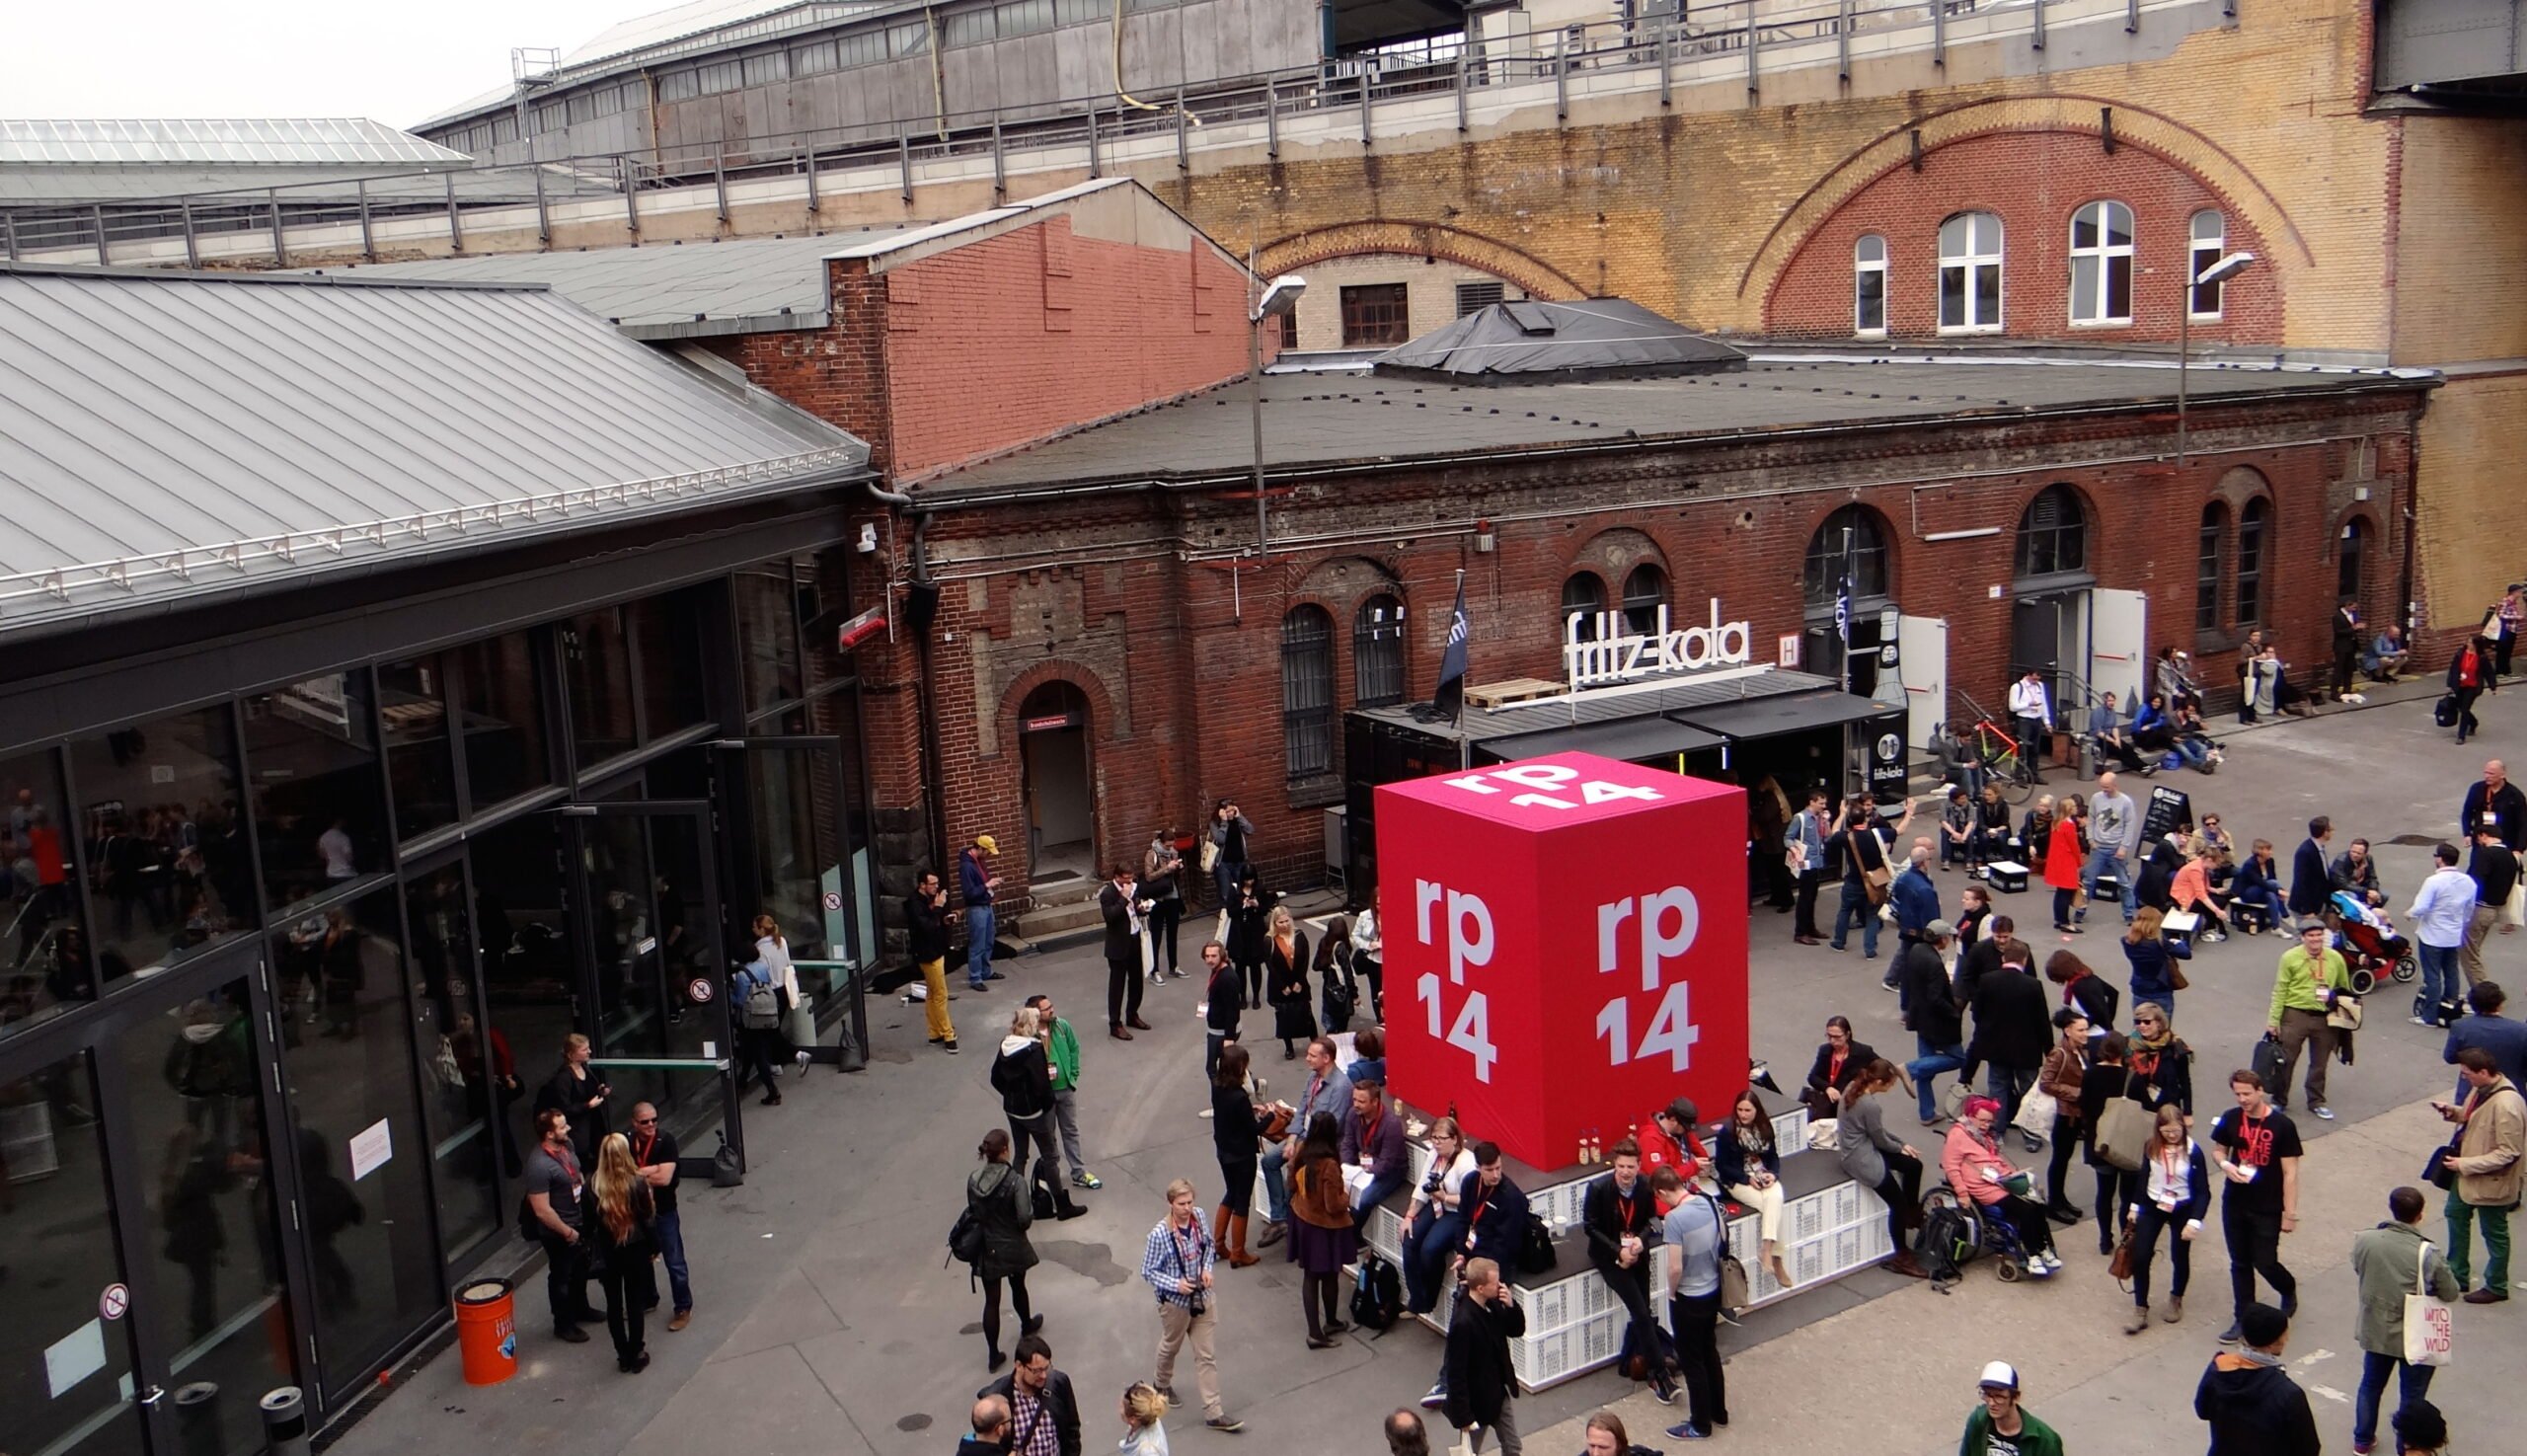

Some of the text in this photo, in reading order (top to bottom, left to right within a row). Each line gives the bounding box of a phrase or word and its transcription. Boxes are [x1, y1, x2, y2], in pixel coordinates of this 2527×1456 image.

[1564, 597, 1750, 684] fritz-kola
[1443, 764, 1578, 795] rp
[1509, 780, 1665, 810] 14
[1416, 878, 1494, 986] rp
[1597, 884, 1700, 992] rp
[1417, 971, 1497, 1085] 14
[1596, 979, 1700, 1073] 14
[2423, 1337, 2451, 1352] WILD
